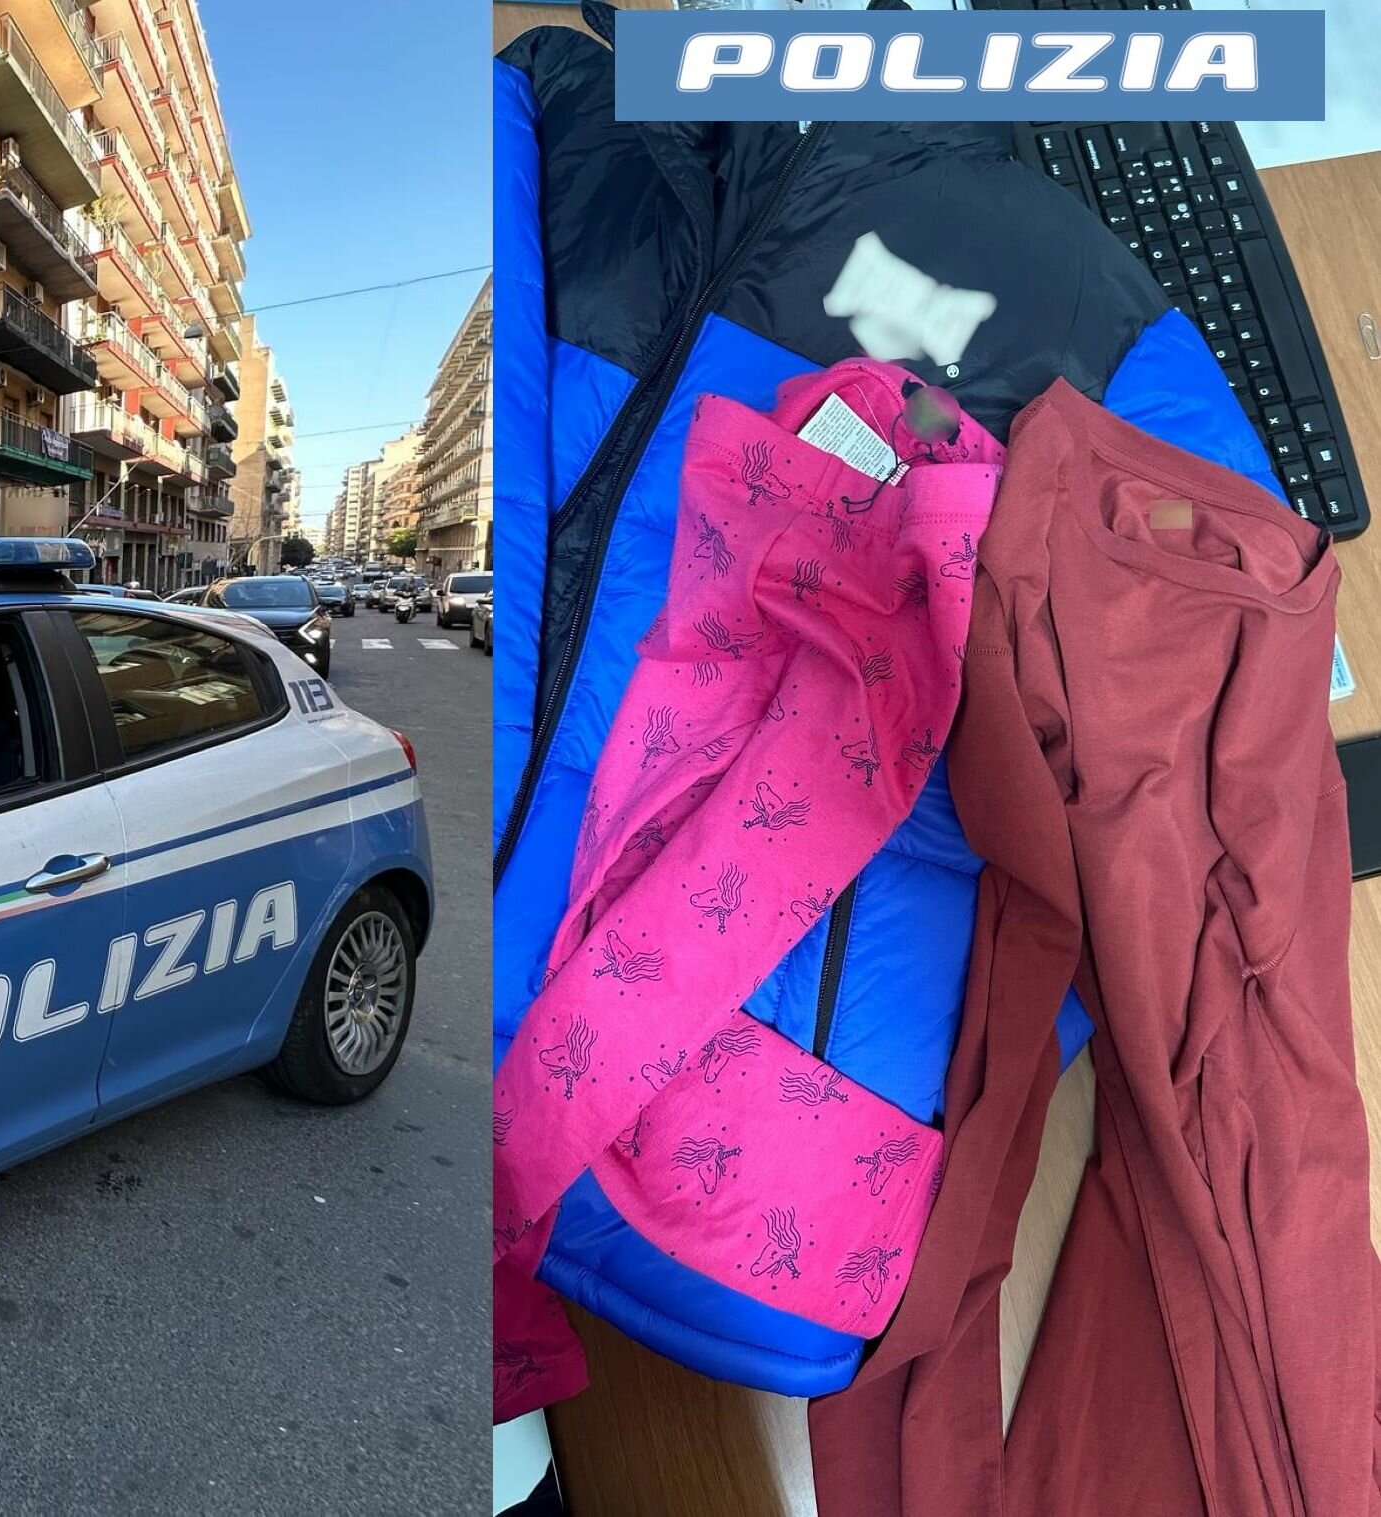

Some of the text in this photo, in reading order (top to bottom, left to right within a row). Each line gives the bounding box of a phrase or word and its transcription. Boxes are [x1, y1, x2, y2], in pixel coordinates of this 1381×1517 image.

[1181, 240, 1190, 248] L
[1189, 266, 1200, 275] K
[1221, 275, 1232, 284] M
[1231, 302, 1242, 311] N
[1207, 322, 1217, 331] H
[1240, 331, 1251, 340] B
[1216, 350, 1226, 359] G
[1268, 417, 1279, 425] X
[1329, 501, 1340, 514] Ctrl
[288, 678, 335, 715] 113
